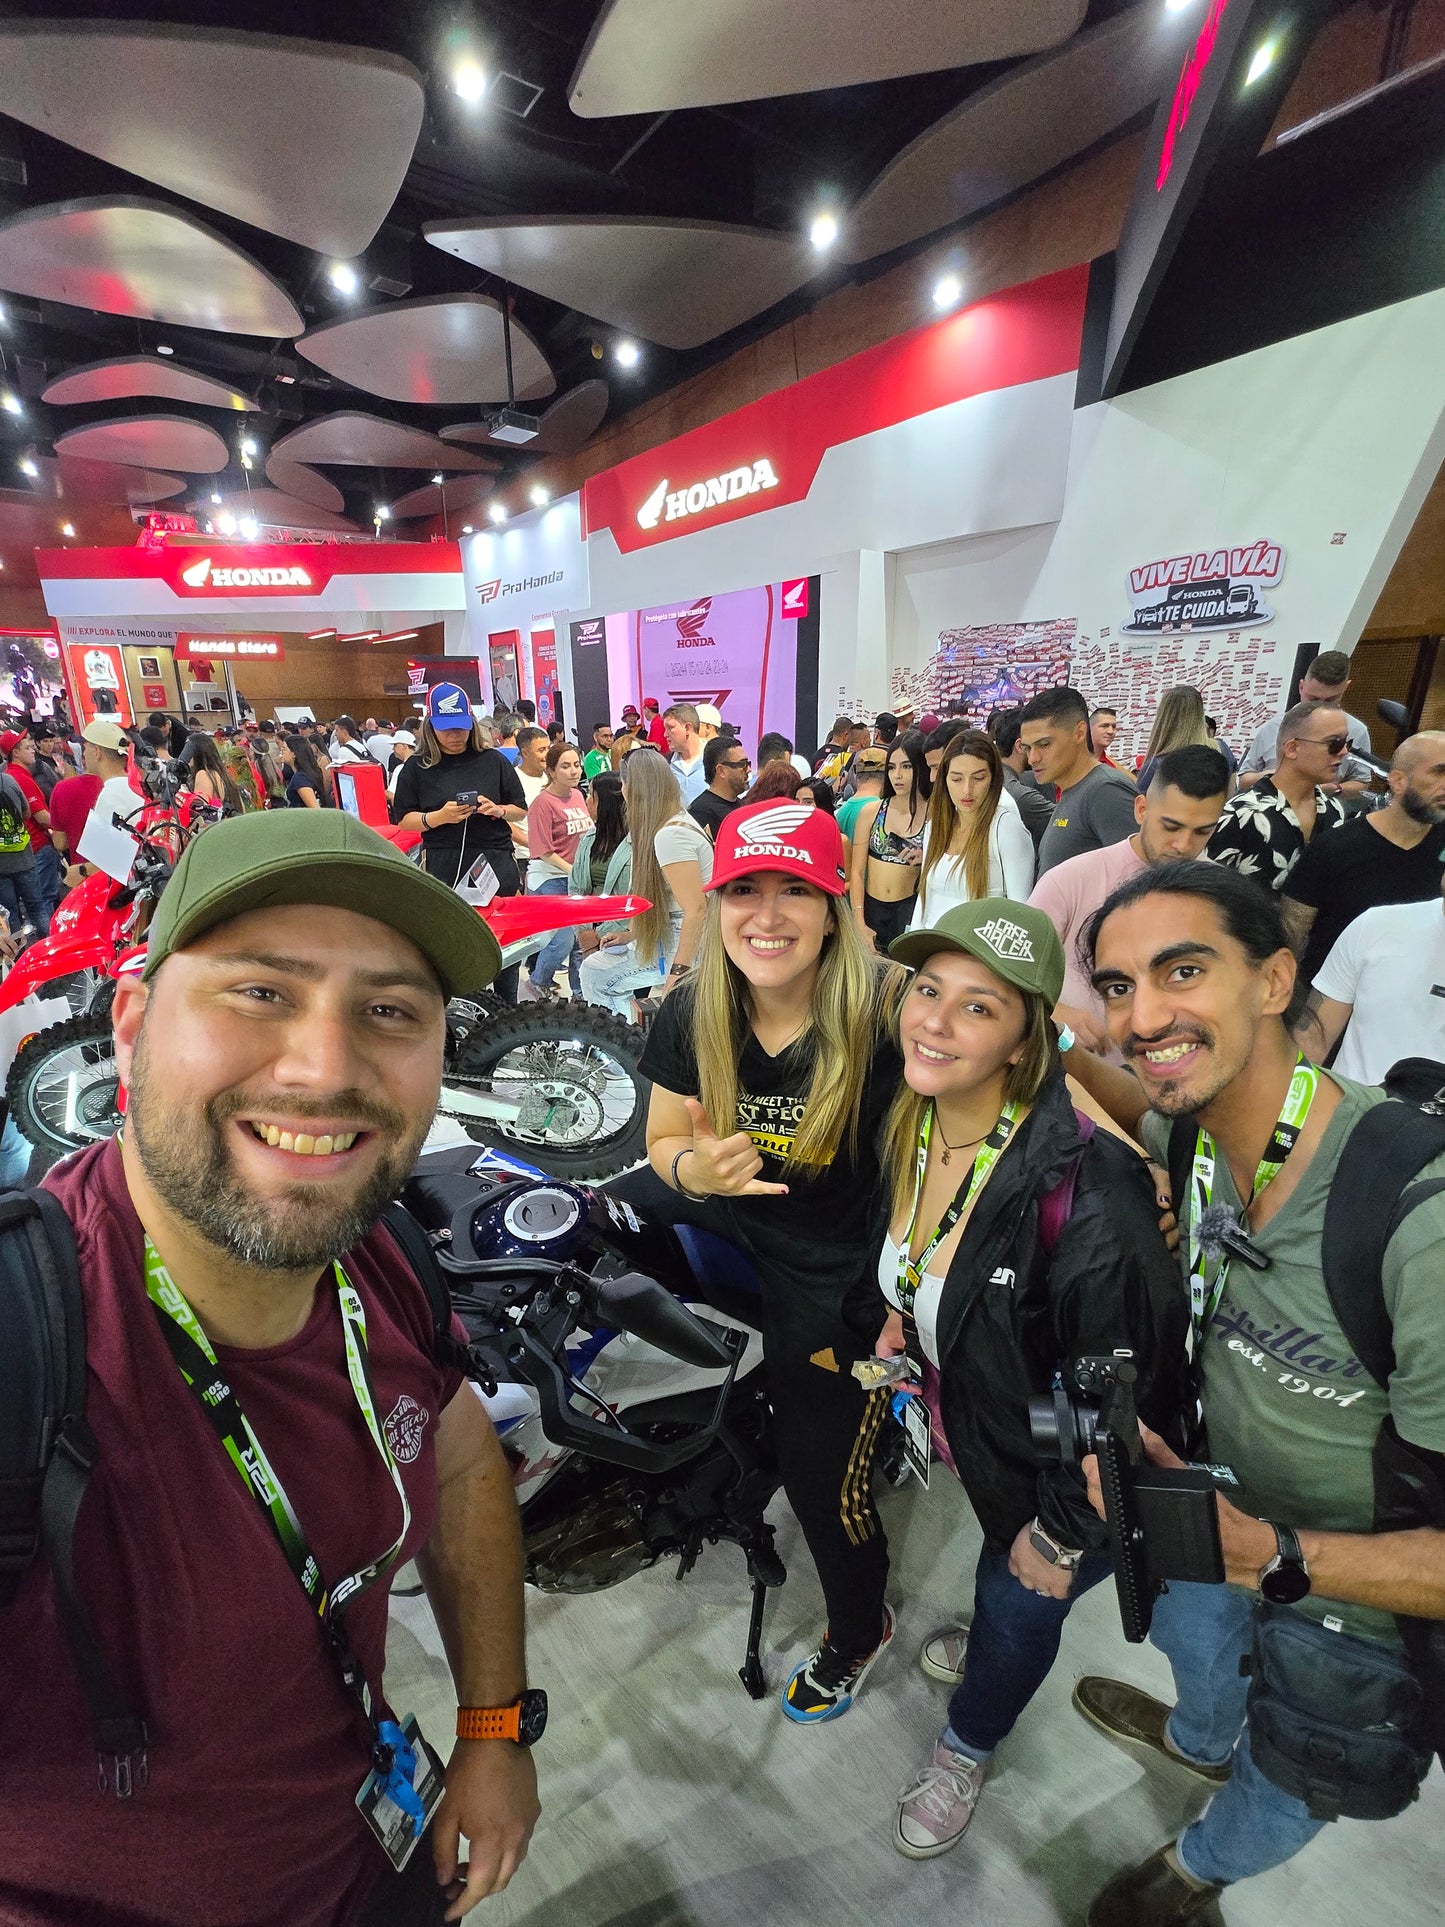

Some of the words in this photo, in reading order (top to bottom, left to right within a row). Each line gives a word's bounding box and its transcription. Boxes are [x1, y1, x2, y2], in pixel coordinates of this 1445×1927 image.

[665, 459, 779, 521] HONDA
[1130, 556, 1192, 593] VIVE
[1190, 550, 1228, 581] LA
[1230, 540, 1281, 577] VÍA
[211, 567, 312, 587] HONDA
[1183, 588, 1223, 600] HONDA
[1165, 604, 1181, 621] TE
[1182, 600, 1225, 620] CUIDA
[79, 627, 115, 636] EXPLORA
[117, 628, 127, 636] EL
[189, 640, 235, 652] Honda
[237, 641, 277, 653] Store
[676, 637, 716, 648] HONDA
[734, 844, 813, 865] HONDA
[981, 920, 1033, 957] RACER
[994, 917, 1029, 943] CAFE
[753, 1095, 784, 1107] MEET
[761, 1123, 776, 1134] ON
[778, 1125, 786, 1135] A
[1227, 1339, 1267, 1373] est.
[1277, 1373, 1366, 1407] 1904
